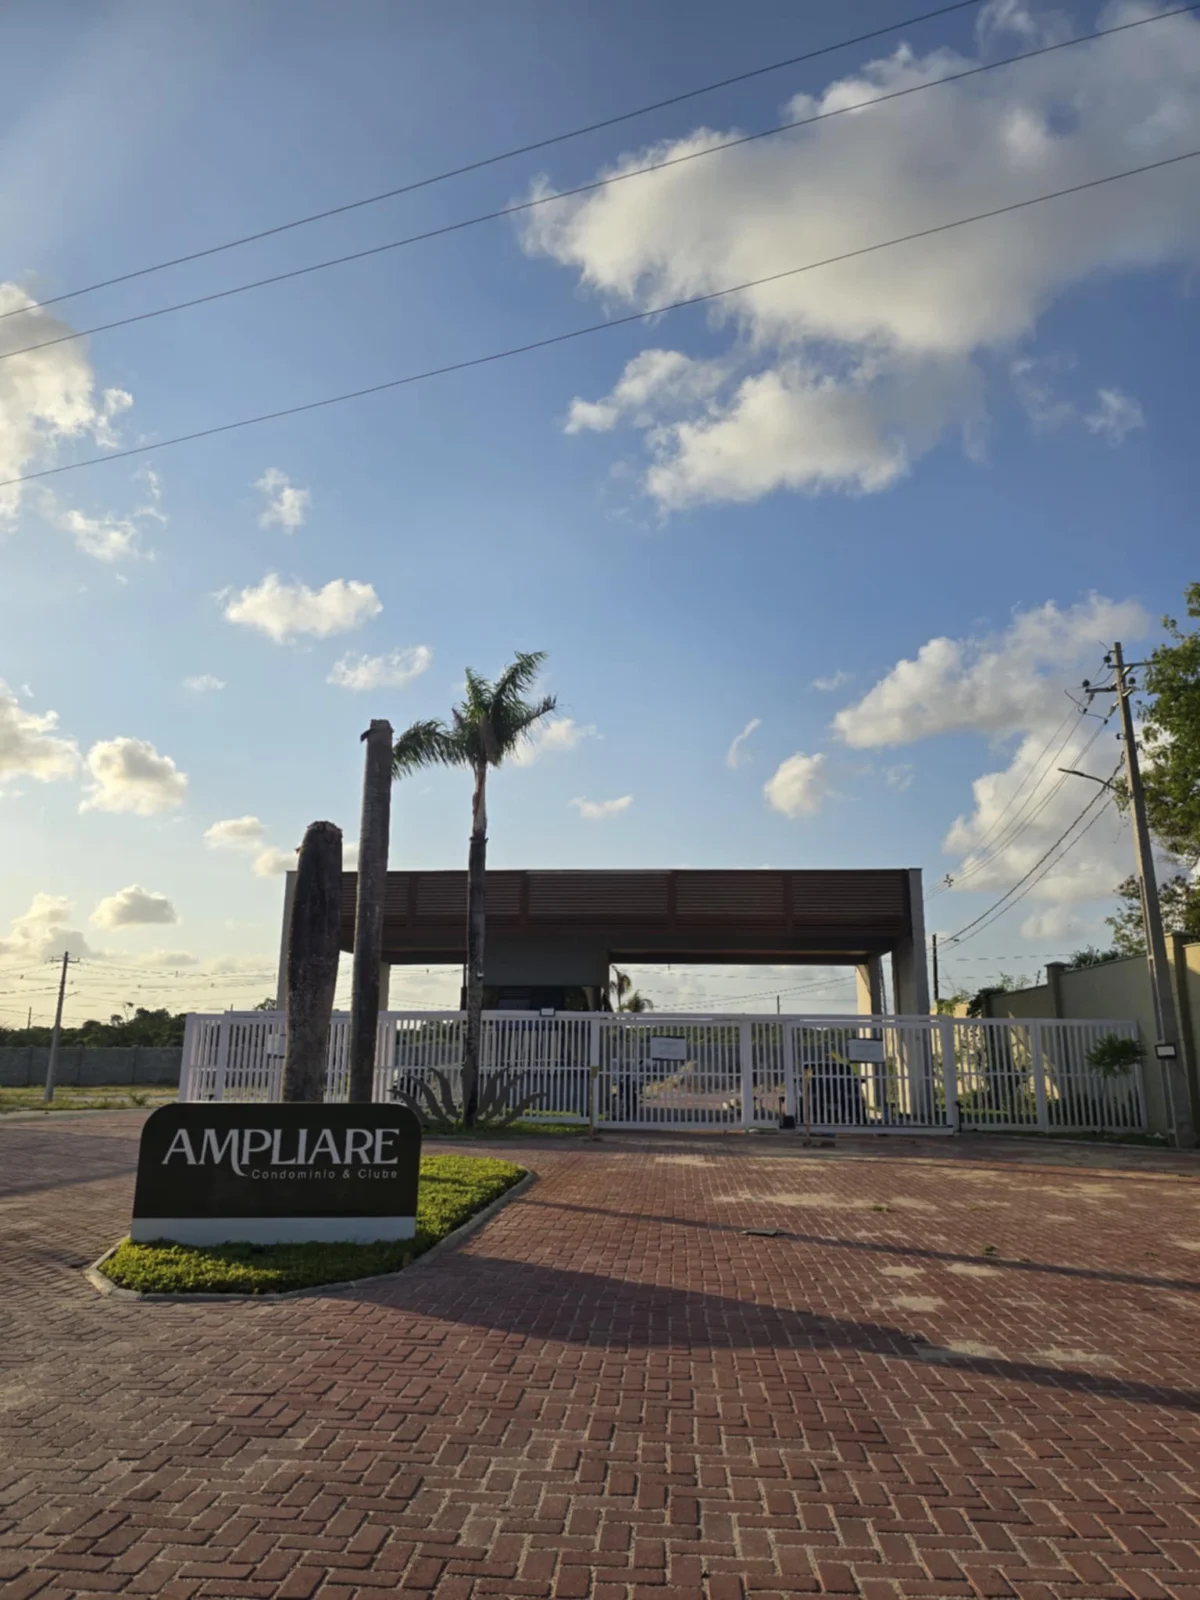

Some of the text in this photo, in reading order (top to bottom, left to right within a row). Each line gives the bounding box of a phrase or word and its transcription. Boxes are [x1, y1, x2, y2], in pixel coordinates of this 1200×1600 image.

[161, 1128, 400, 1176] AMPLIARE
[342, 1168, 350, 1178] &
[357, 1168, 398, 1178] Clube
